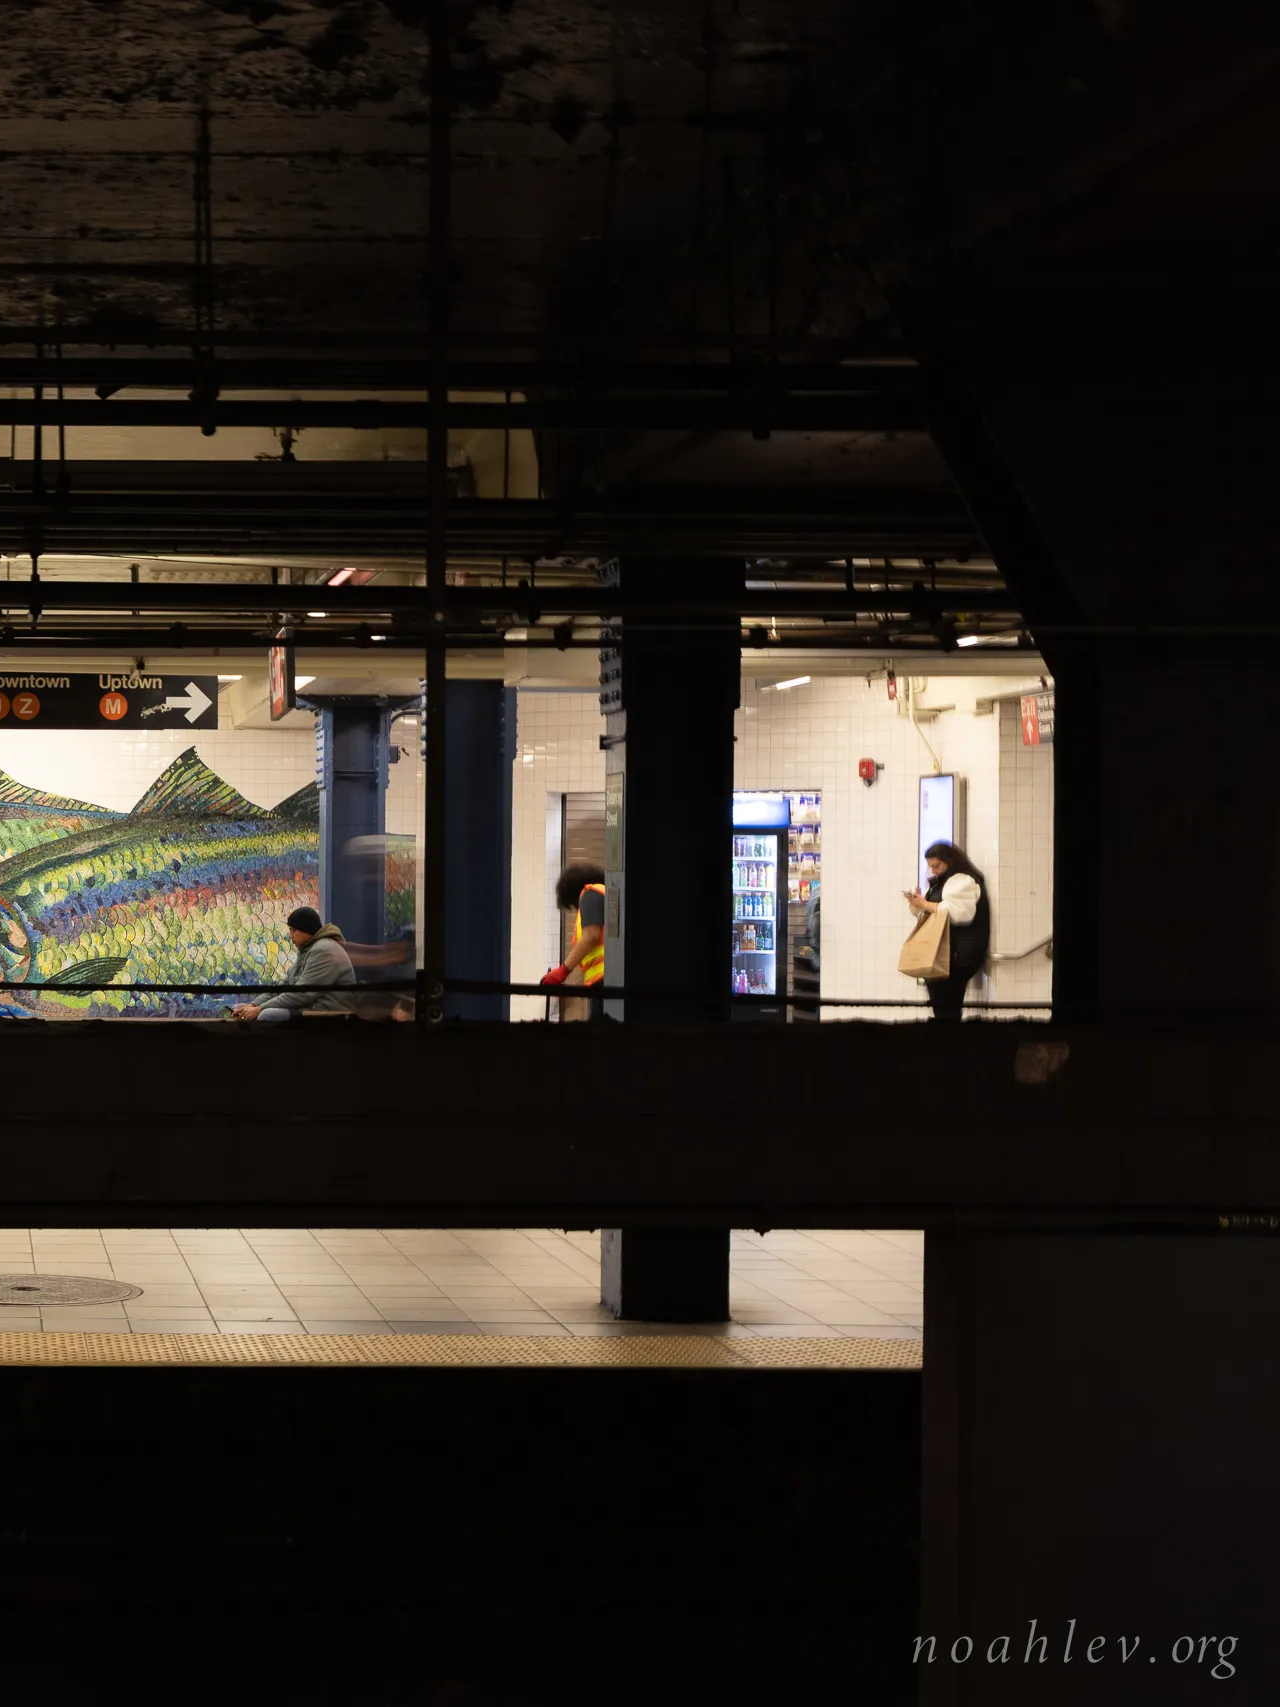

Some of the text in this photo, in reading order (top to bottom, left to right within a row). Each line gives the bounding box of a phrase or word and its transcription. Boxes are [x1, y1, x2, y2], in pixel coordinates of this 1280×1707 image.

[99, 674, 162, 691] Uptown
[20, 699, 33, 714] Z
[105, 699, 121, 714] M
